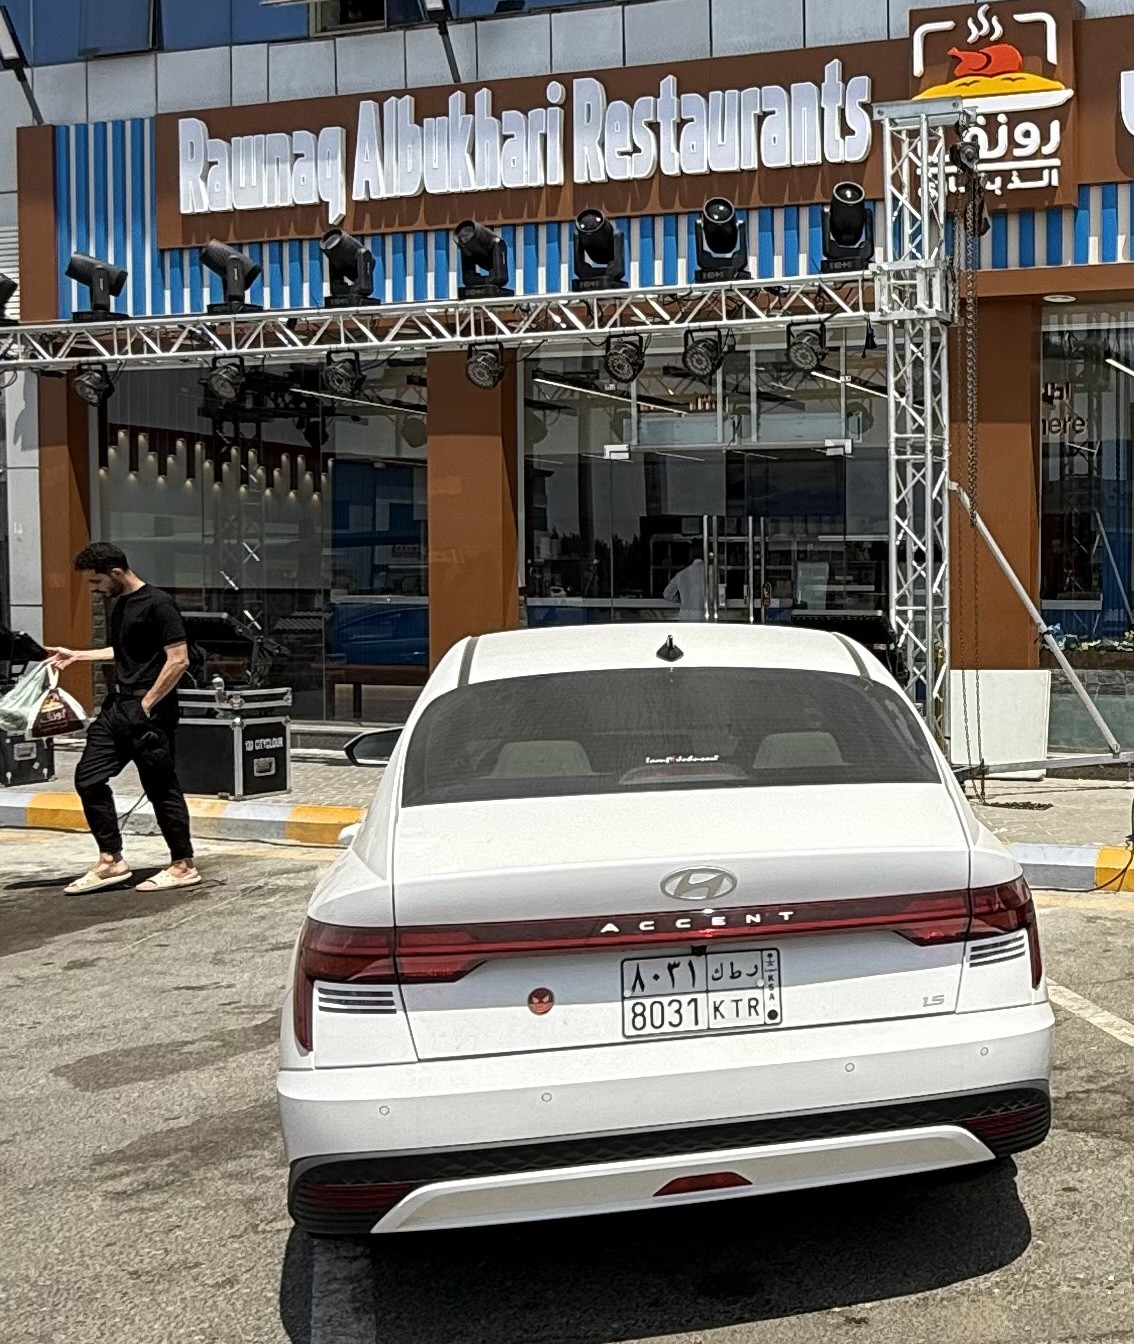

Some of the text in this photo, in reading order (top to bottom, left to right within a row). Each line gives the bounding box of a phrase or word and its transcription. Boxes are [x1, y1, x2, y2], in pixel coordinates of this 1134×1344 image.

[178, 58, 870, 226] Rawnaq Albukhari Restaurants
[600, 911, 794, 934] ACCENT
[767, 974, 776, 1001] KSA
[631, 997, 700, 1031] 8031
